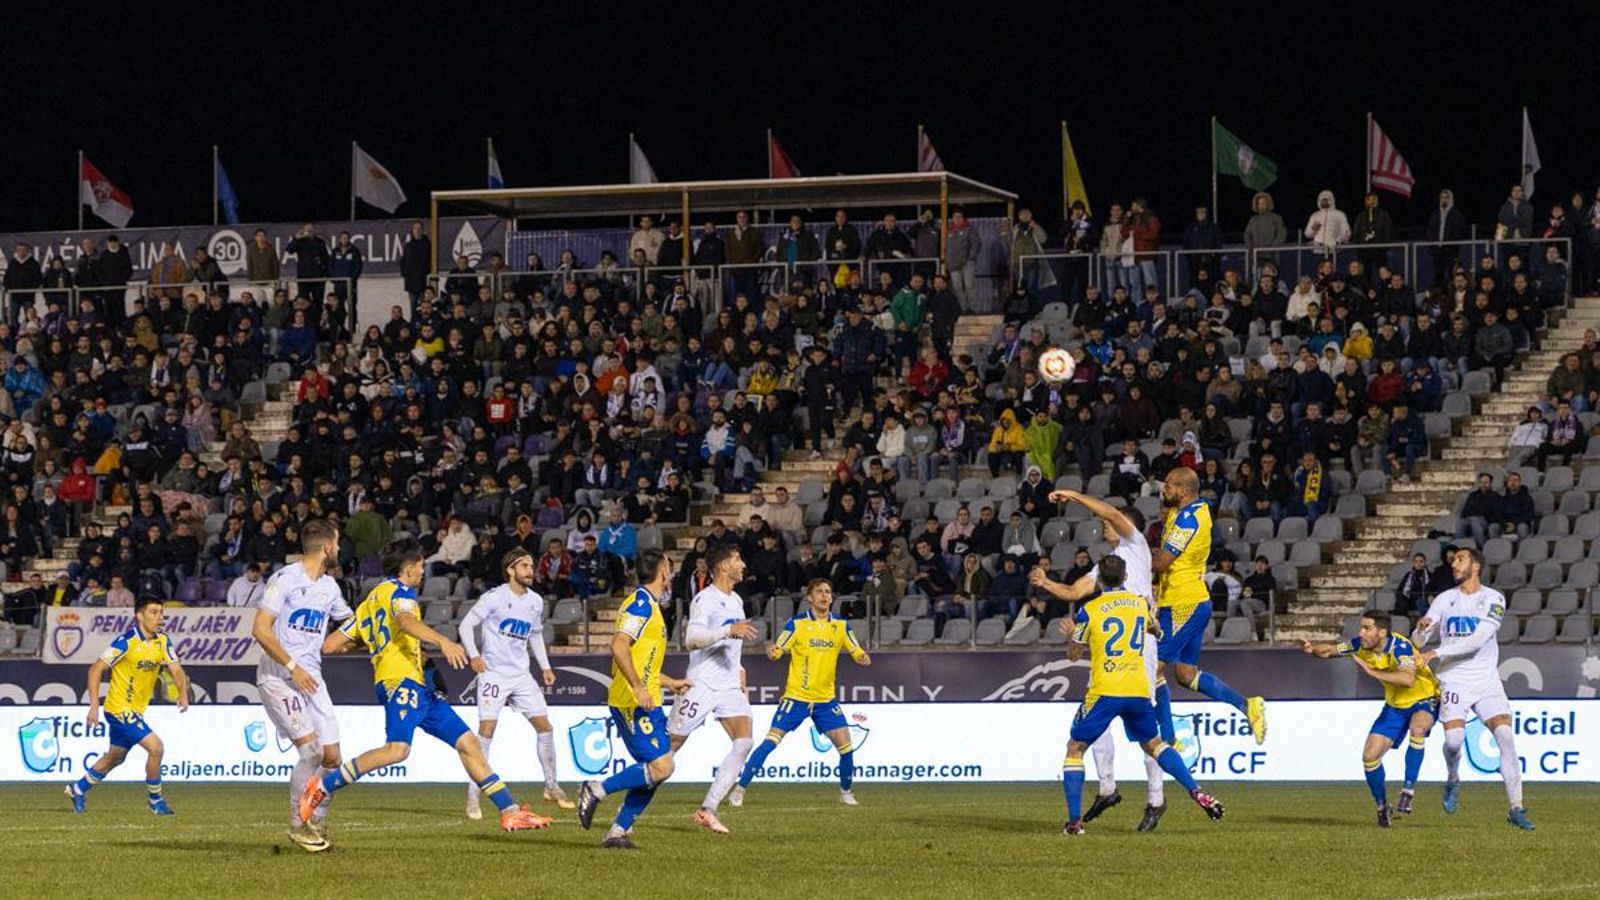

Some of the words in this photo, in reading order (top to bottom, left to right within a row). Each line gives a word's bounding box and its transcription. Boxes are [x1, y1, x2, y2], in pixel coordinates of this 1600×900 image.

[215, 241, 240, 260] 30
[191, 610, 241, 633] JAÉN
[1102, 616, 1145, 656] 24
[396, 687, 418, 709] 33
[482, 683, 500, 698] 20
[1443, 691, 1459, 705] 30
[282, 696, 302, 715] 14
[679, 699, 699, 718] 25
[53, 716, 106, 738] ficia
[640, 717, 653, 735] 6
[1193, 713, 1254, 736] ficia
[1514, 711, 1575, 735] icial
[1229, 752, 1267, 774] CF
[1540, 752, 1580, 774] CF
